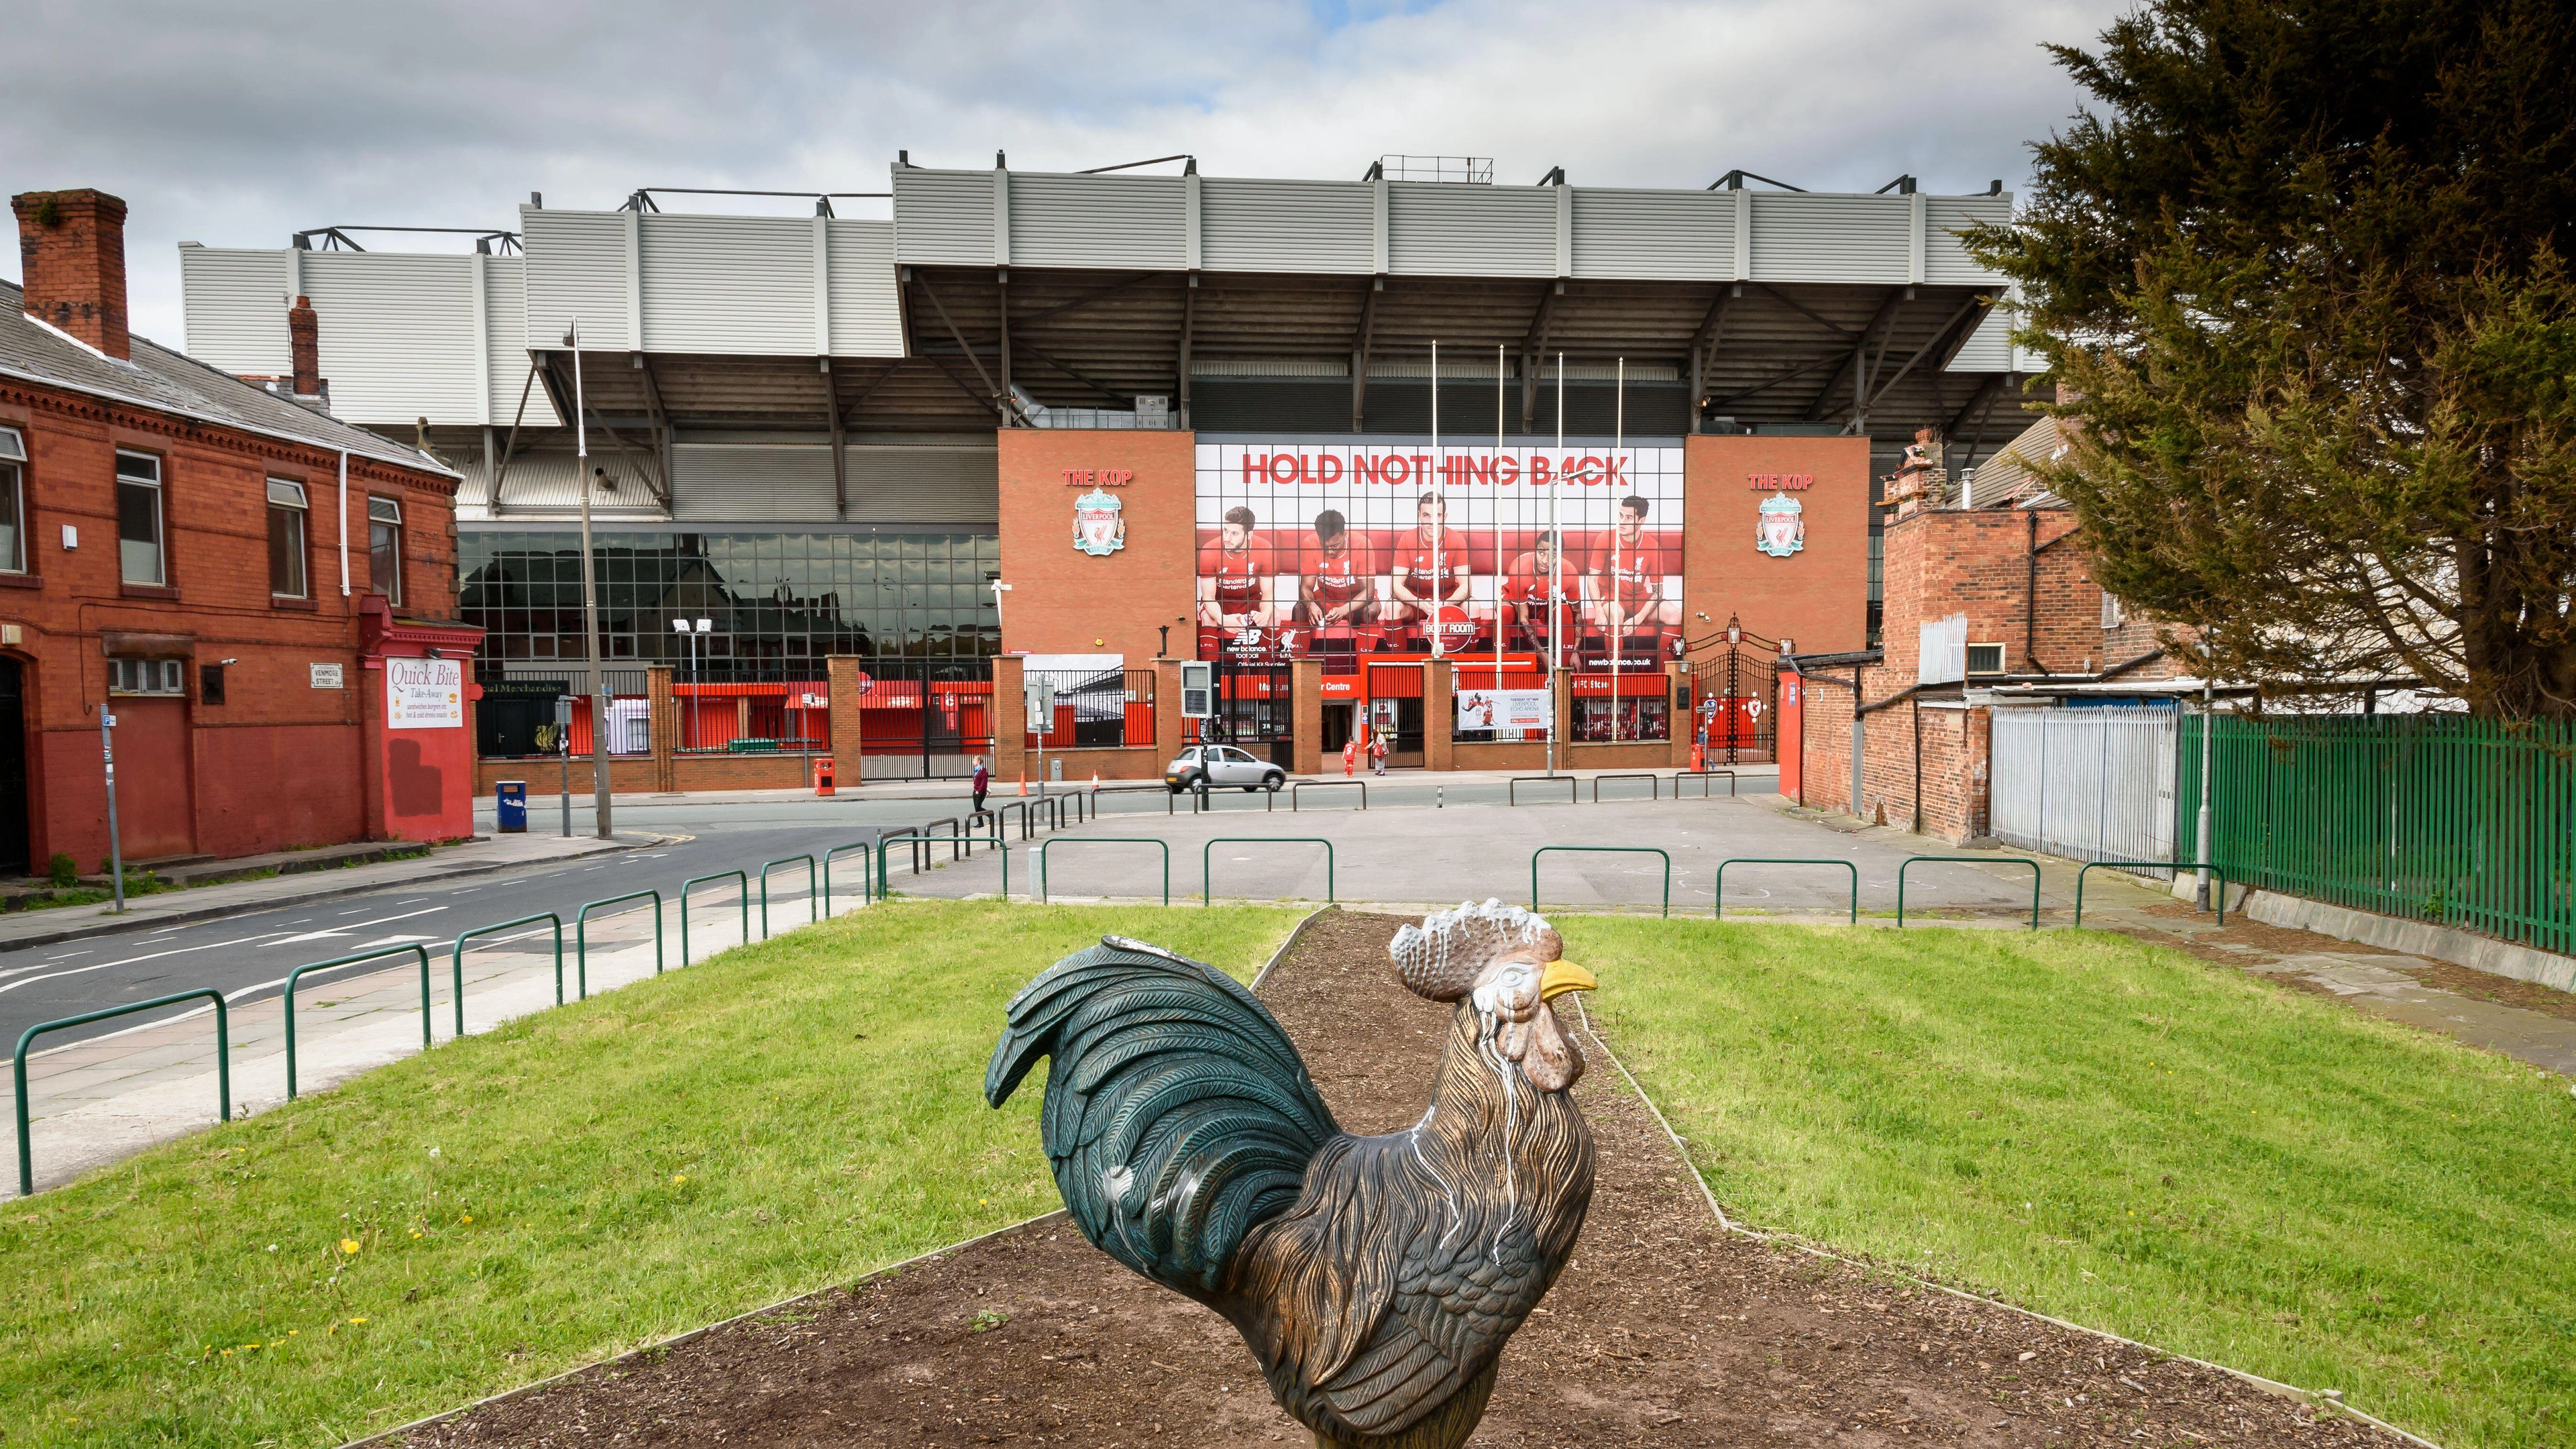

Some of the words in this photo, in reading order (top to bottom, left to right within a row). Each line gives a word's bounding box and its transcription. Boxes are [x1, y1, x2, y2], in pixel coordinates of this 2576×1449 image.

[1243, 453, 1343, 484] HOLD
[1354, 454, 1519, 486] NOTHING
[1530, 456, 1629, 486] BACK
[1063, 470, 1093, 485] THE
[1099, 470, 1132, 486] KOP
[1748, 474, 1778, 490] THE
[1782, 474, 1813, 490] KOP
[1449, 624, 1474, 633] ROOM
[391, 662, 431, 692] Quick
[435, 664, 459, 686] Bite
[500, 684, 561, 692] Merchandise
[1326, 682, 1350, 691] Centre
[411, 688, 443, 702] Take-Away
[427, 703, 441, 711] burgers
[1346, 747, 1352, 755] 9
